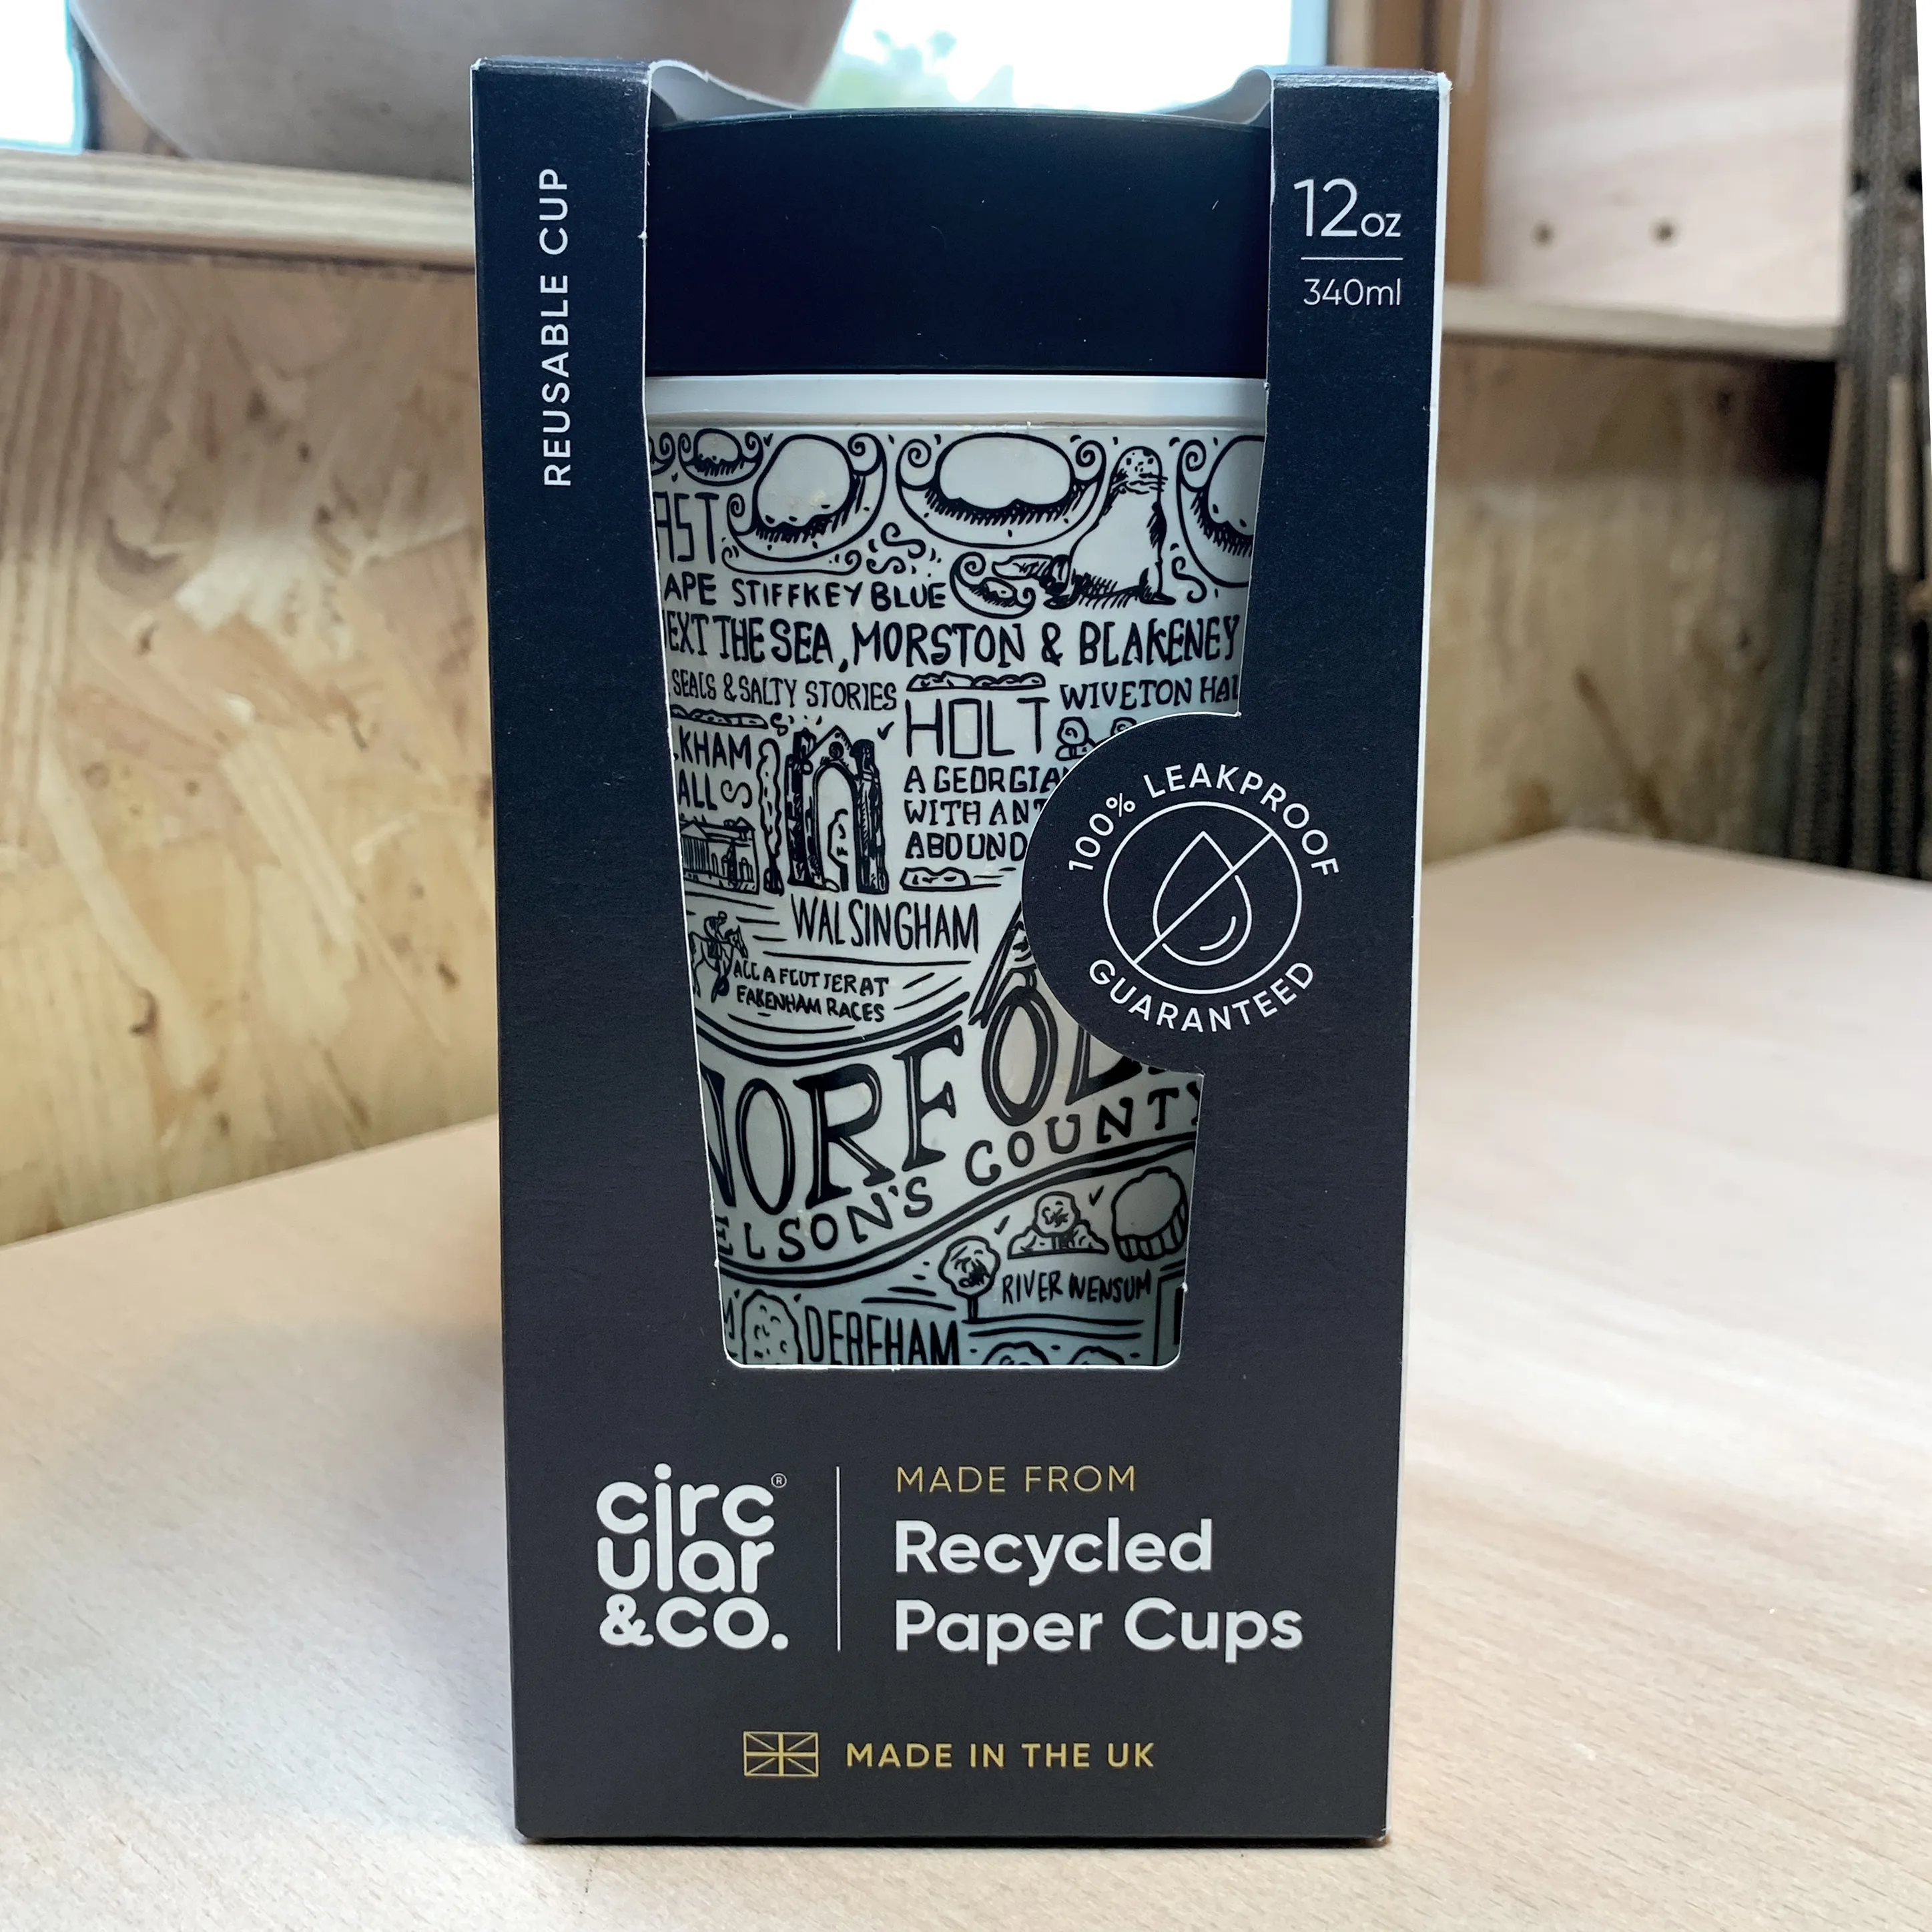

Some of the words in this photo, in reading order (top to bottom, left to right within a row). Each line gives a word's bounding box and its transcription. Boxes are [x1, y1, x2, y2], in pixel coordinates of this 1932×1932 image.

[539, 169, 568, 255] CUP
[1294, 178, 1401, 237] 12oz
[1304, 278, 1400, 306] 340ml
[540, 276, 571, 486] REUSABLE
[732, 578, 864, 608] STIFFKEY
[871, 581, 947, 611] BLUE
[661, 609, 709, 655] EXT
[712, 615, 765, 662] THE
[852, 620, 1025, 668] MORSTON
[1040, 622, 1063, 667] &
[1079, 614, 1241, 667] BLAKENEY
[671, 668, 717, 700] SEALS
[723, 672, 737, 702] &
[738, 675, 797, 708] SALTY
[805, 679, 897, 711] STORIES
[1059, 677, 1193, 711] WIVETON
[673, 725, 752, 770] KHAM
[904, 696, 1050, 759] HOLT
[904, 765, 926, 794] A
[934, 765, 1070, 794] GEORGIA
[904, 799, 981, 827] WITH
[1068, 792, 1136, 872] 100%
[1143, 762, 1340, 876] LEAKPROOF
[904, 830, 1028, 862] ABOUND
[790, 894, 980, 954] WALSINGHAM
[736, 984, 822, 1016] FAKENHAM
[826, 997, 885, 1022] RACES
[1088, 959, 1314, 1033] GUARANTEED
[1002, 1269, 1063, 1305] RIVER
[1068, 1268, 1151, 1303] WENSUM
[898, 1466, 1005, 1492] MADE
[1026, 1466, 1134, 1492] FROM
[896, 1518, 1212, 1586] Recycled
[896, 1600, 1102, 1666] Paper
[1124, 1598, 1303, 1663] Cups
[847, 1743, 952, 1768] MADE
[970, 1744, 1004, 1768] IN
[1022, 1743, 1090, 1767] THE
[1108, 1743, 1154, 1768] UK
